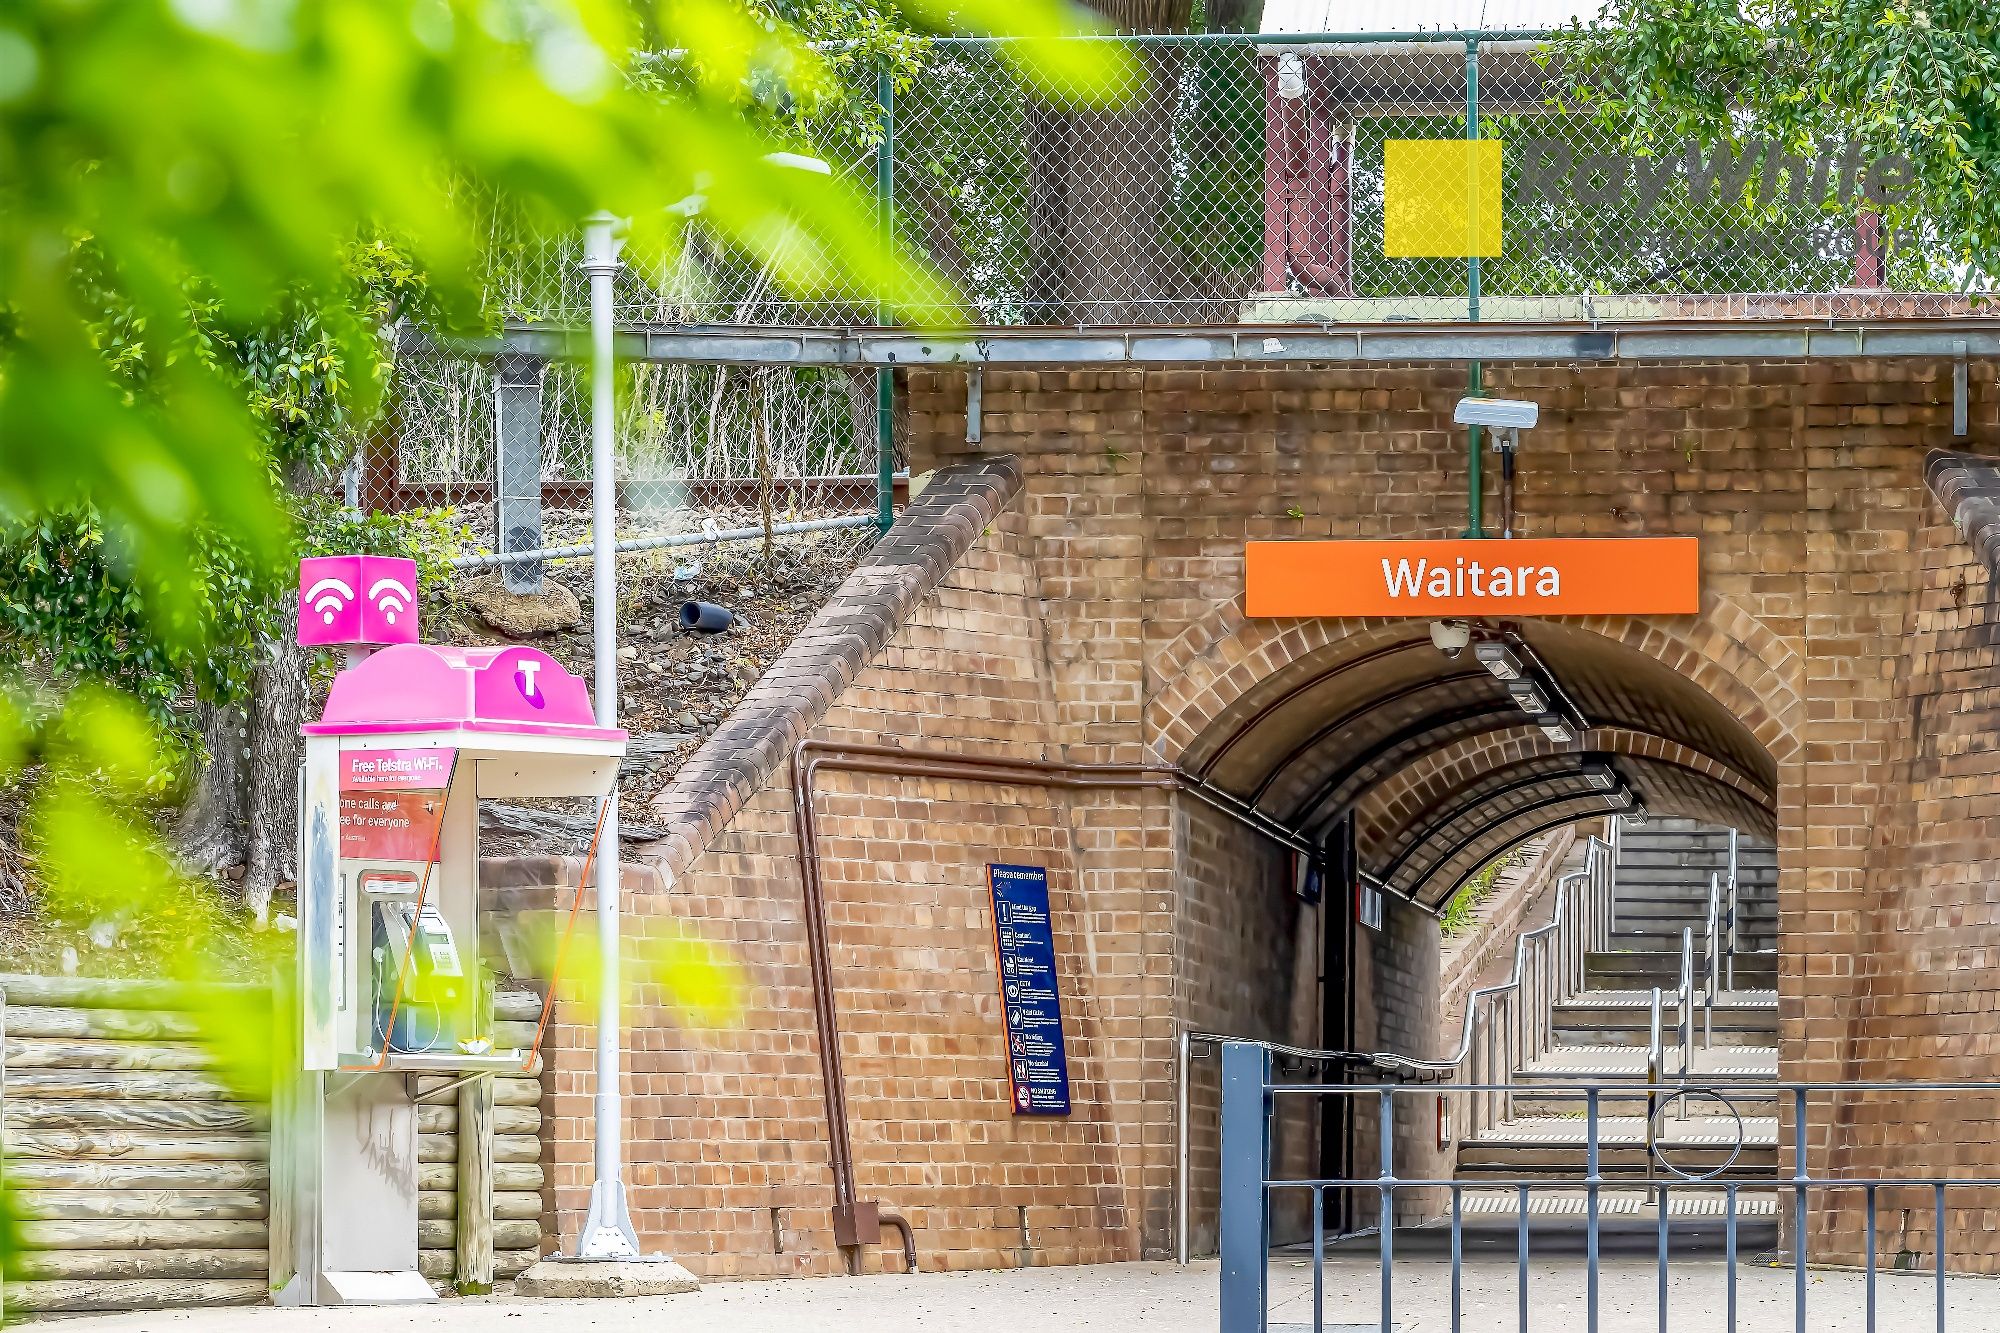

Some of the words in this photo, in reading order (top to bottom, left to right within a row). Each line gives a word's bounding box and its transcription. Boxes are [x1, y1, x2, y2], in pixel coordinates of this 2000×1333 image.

[1381, 557, 1560, 597] Waitara
[517, 660, 541, 696] T
[352, 759, 375, 772] Free
[376, 758, 412, 772] Telstra
[358, 798, 379, 810] calls
[353, 813, 366, 825] for
[368, 816, 410, 830] everyone
[993, 868, 1013, 879] Please
